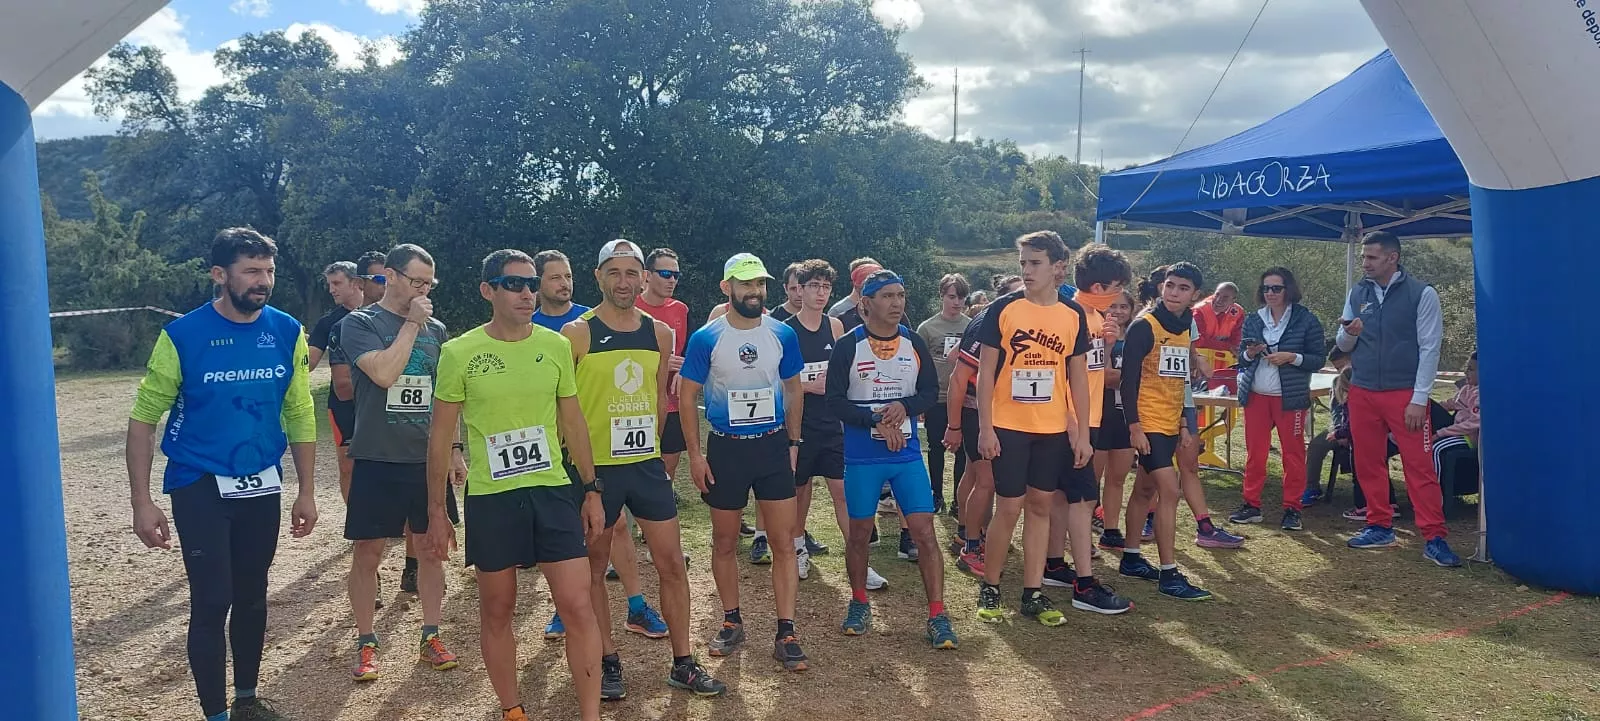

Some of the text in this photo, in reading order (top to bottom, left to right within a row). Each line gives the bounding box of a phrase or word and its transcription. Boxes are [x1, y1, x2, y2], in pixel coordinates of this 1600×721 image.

[1198, 161, 1332, 200] RIBAGORZA
[1166, 357, 1186, 371] 161
[401, 388, 422, 404] 68
[1029, 381, 1037, 396] 1
[607, 402, 650, 412] CORRER
[746, 403, 757, 418] 7
[624, 430, 646, 448] 40
[498, 443, 542, 469] 194
[232, 475, 263, 491] 35
